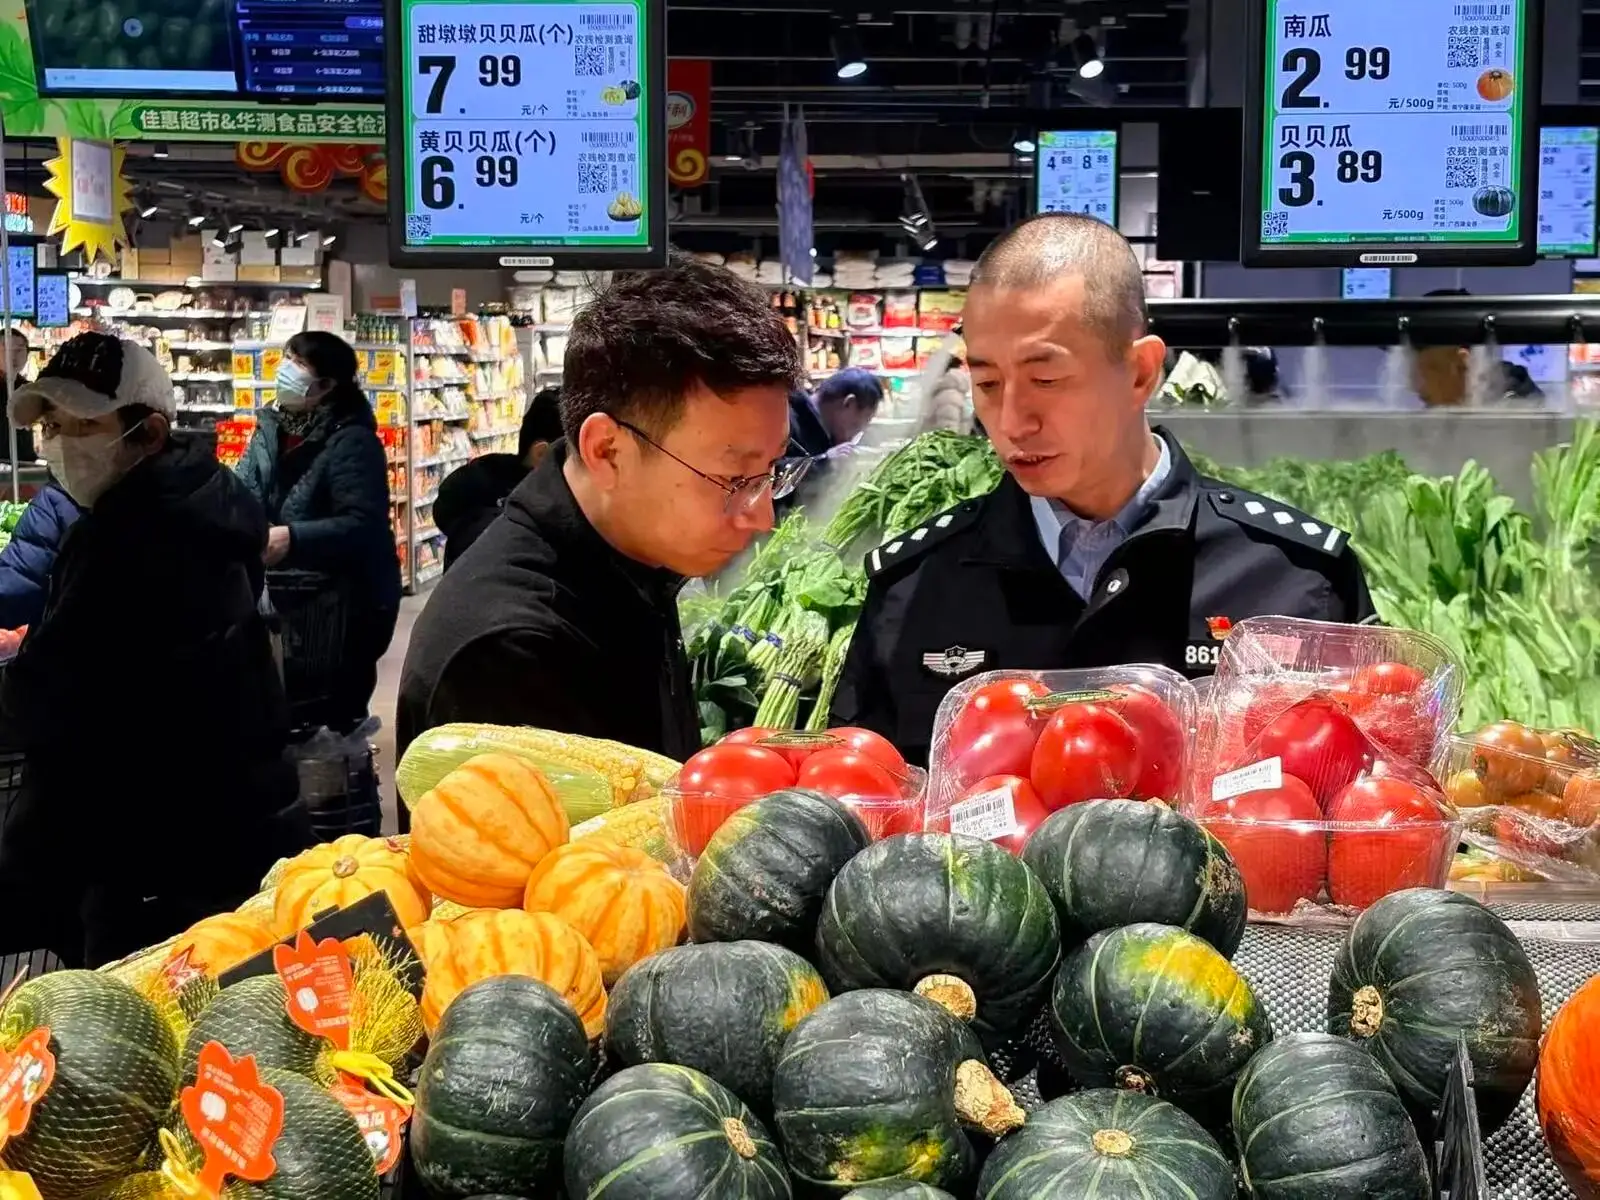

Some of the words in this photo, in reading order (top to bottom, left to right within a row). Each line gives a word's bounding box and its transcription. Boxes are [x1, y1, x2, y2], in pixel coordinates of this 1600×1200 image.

[417, 23, 574, 46] 甜墩墩贝贝瓜(个)
[1283, 14, 1332, 38] 南瓜
[520, 104, 549, 116] 元/个
[1388, 97, 1434, 110] 元/500g
[418, 129, 556, 155] 黄贝贝瓜(个)
[1279, 124, 1353, 148] 贝贝瓜
[520, 212, 544, 224] 元/个
[1382, 209, 1424, 220] 元/500g
[1185, 645, 1220, 664] 861
